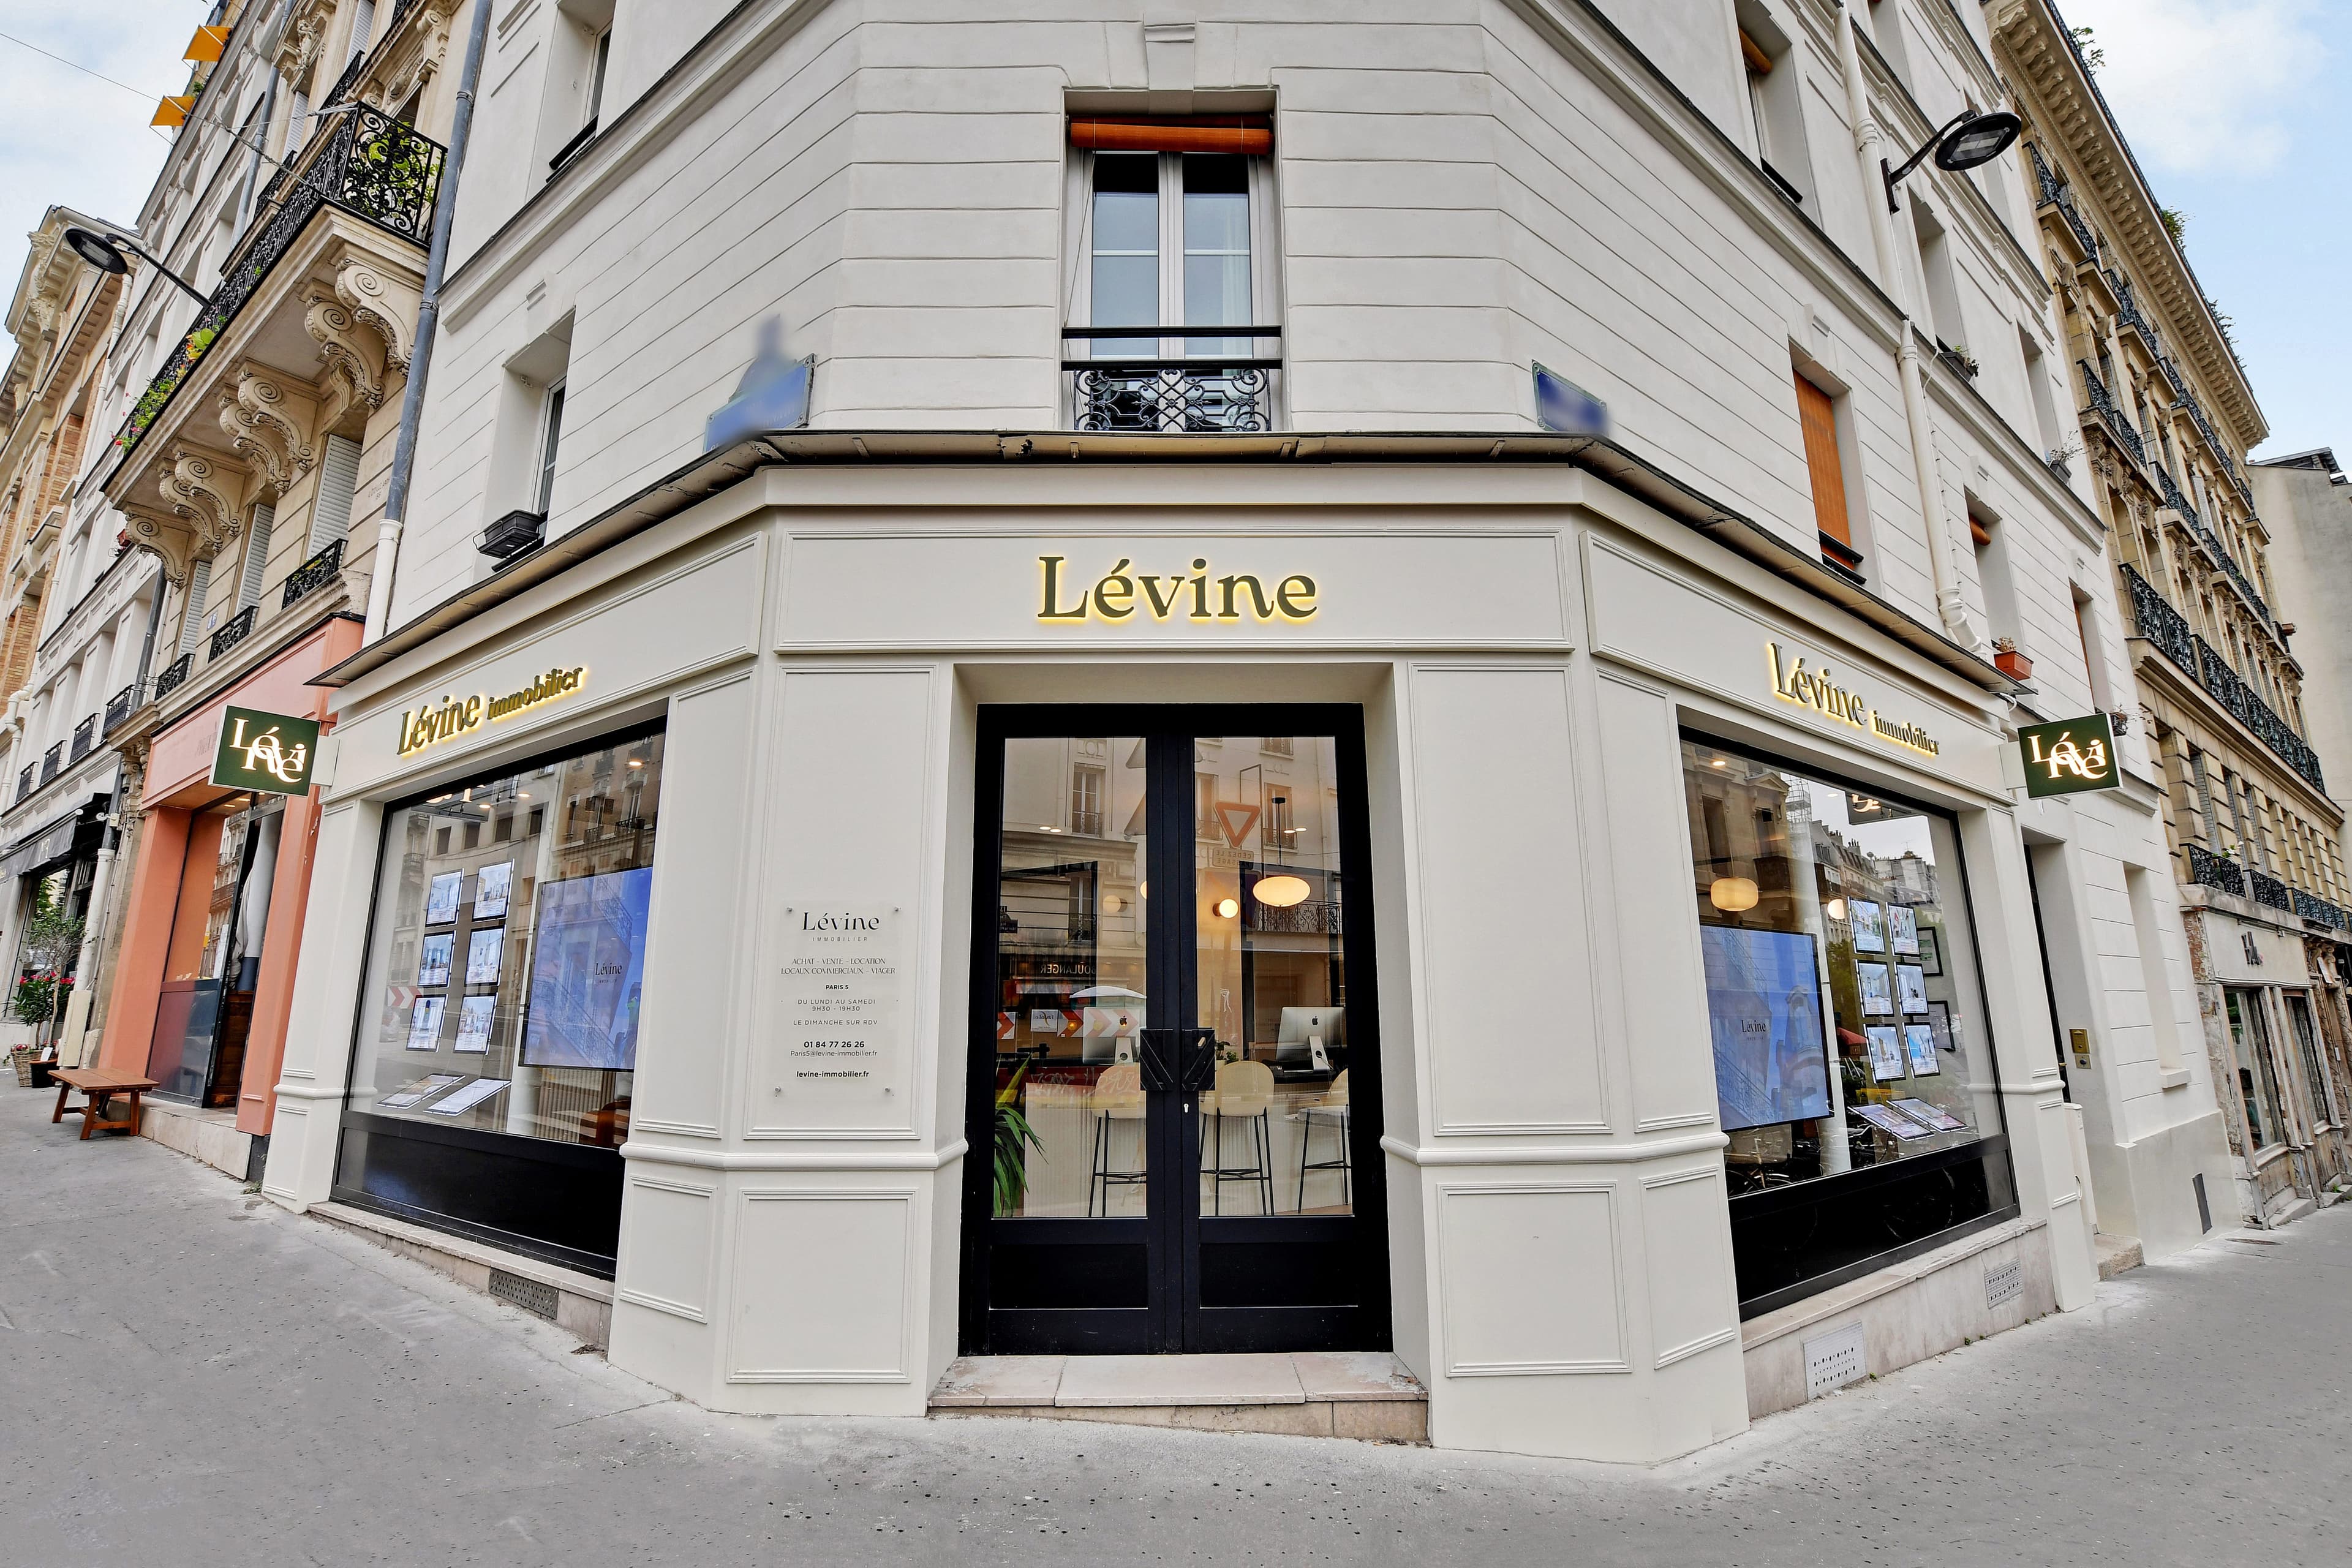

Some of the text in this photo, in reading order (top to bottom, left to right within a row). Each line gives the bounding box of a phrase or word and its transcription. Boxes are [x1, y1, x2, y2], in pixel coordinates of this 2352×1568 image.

[1037, 556, 1317, 619] Lévine
[396, 667, 584, 755] Lévine immobilier
[1770, 643, 1940, 755] Lévine immobilier
[802, 911, 880, 930] Lévine
